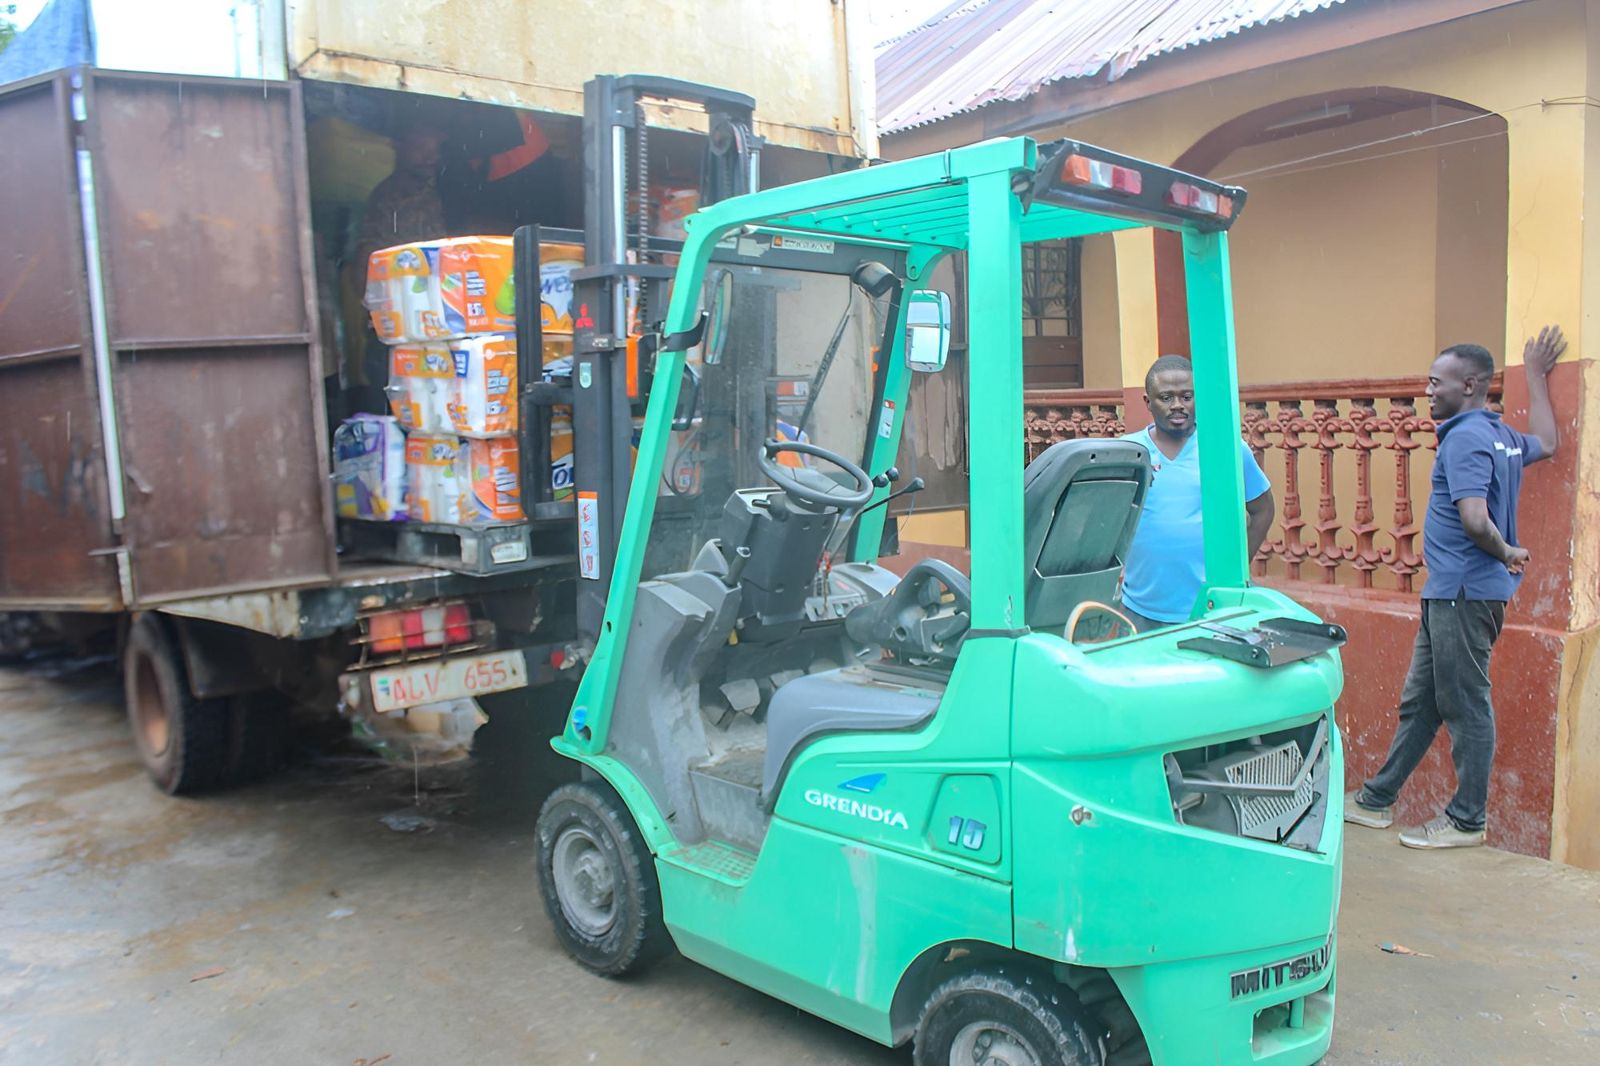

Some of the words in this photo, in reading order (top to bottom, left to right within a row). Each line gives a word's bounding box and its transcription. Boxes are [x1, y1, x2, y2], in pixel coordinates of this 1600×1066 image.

[393, 671, 440, 701] ALV
[463, 660, 508, 689] 655
[804, 789, 909, 830] GRENDIA
